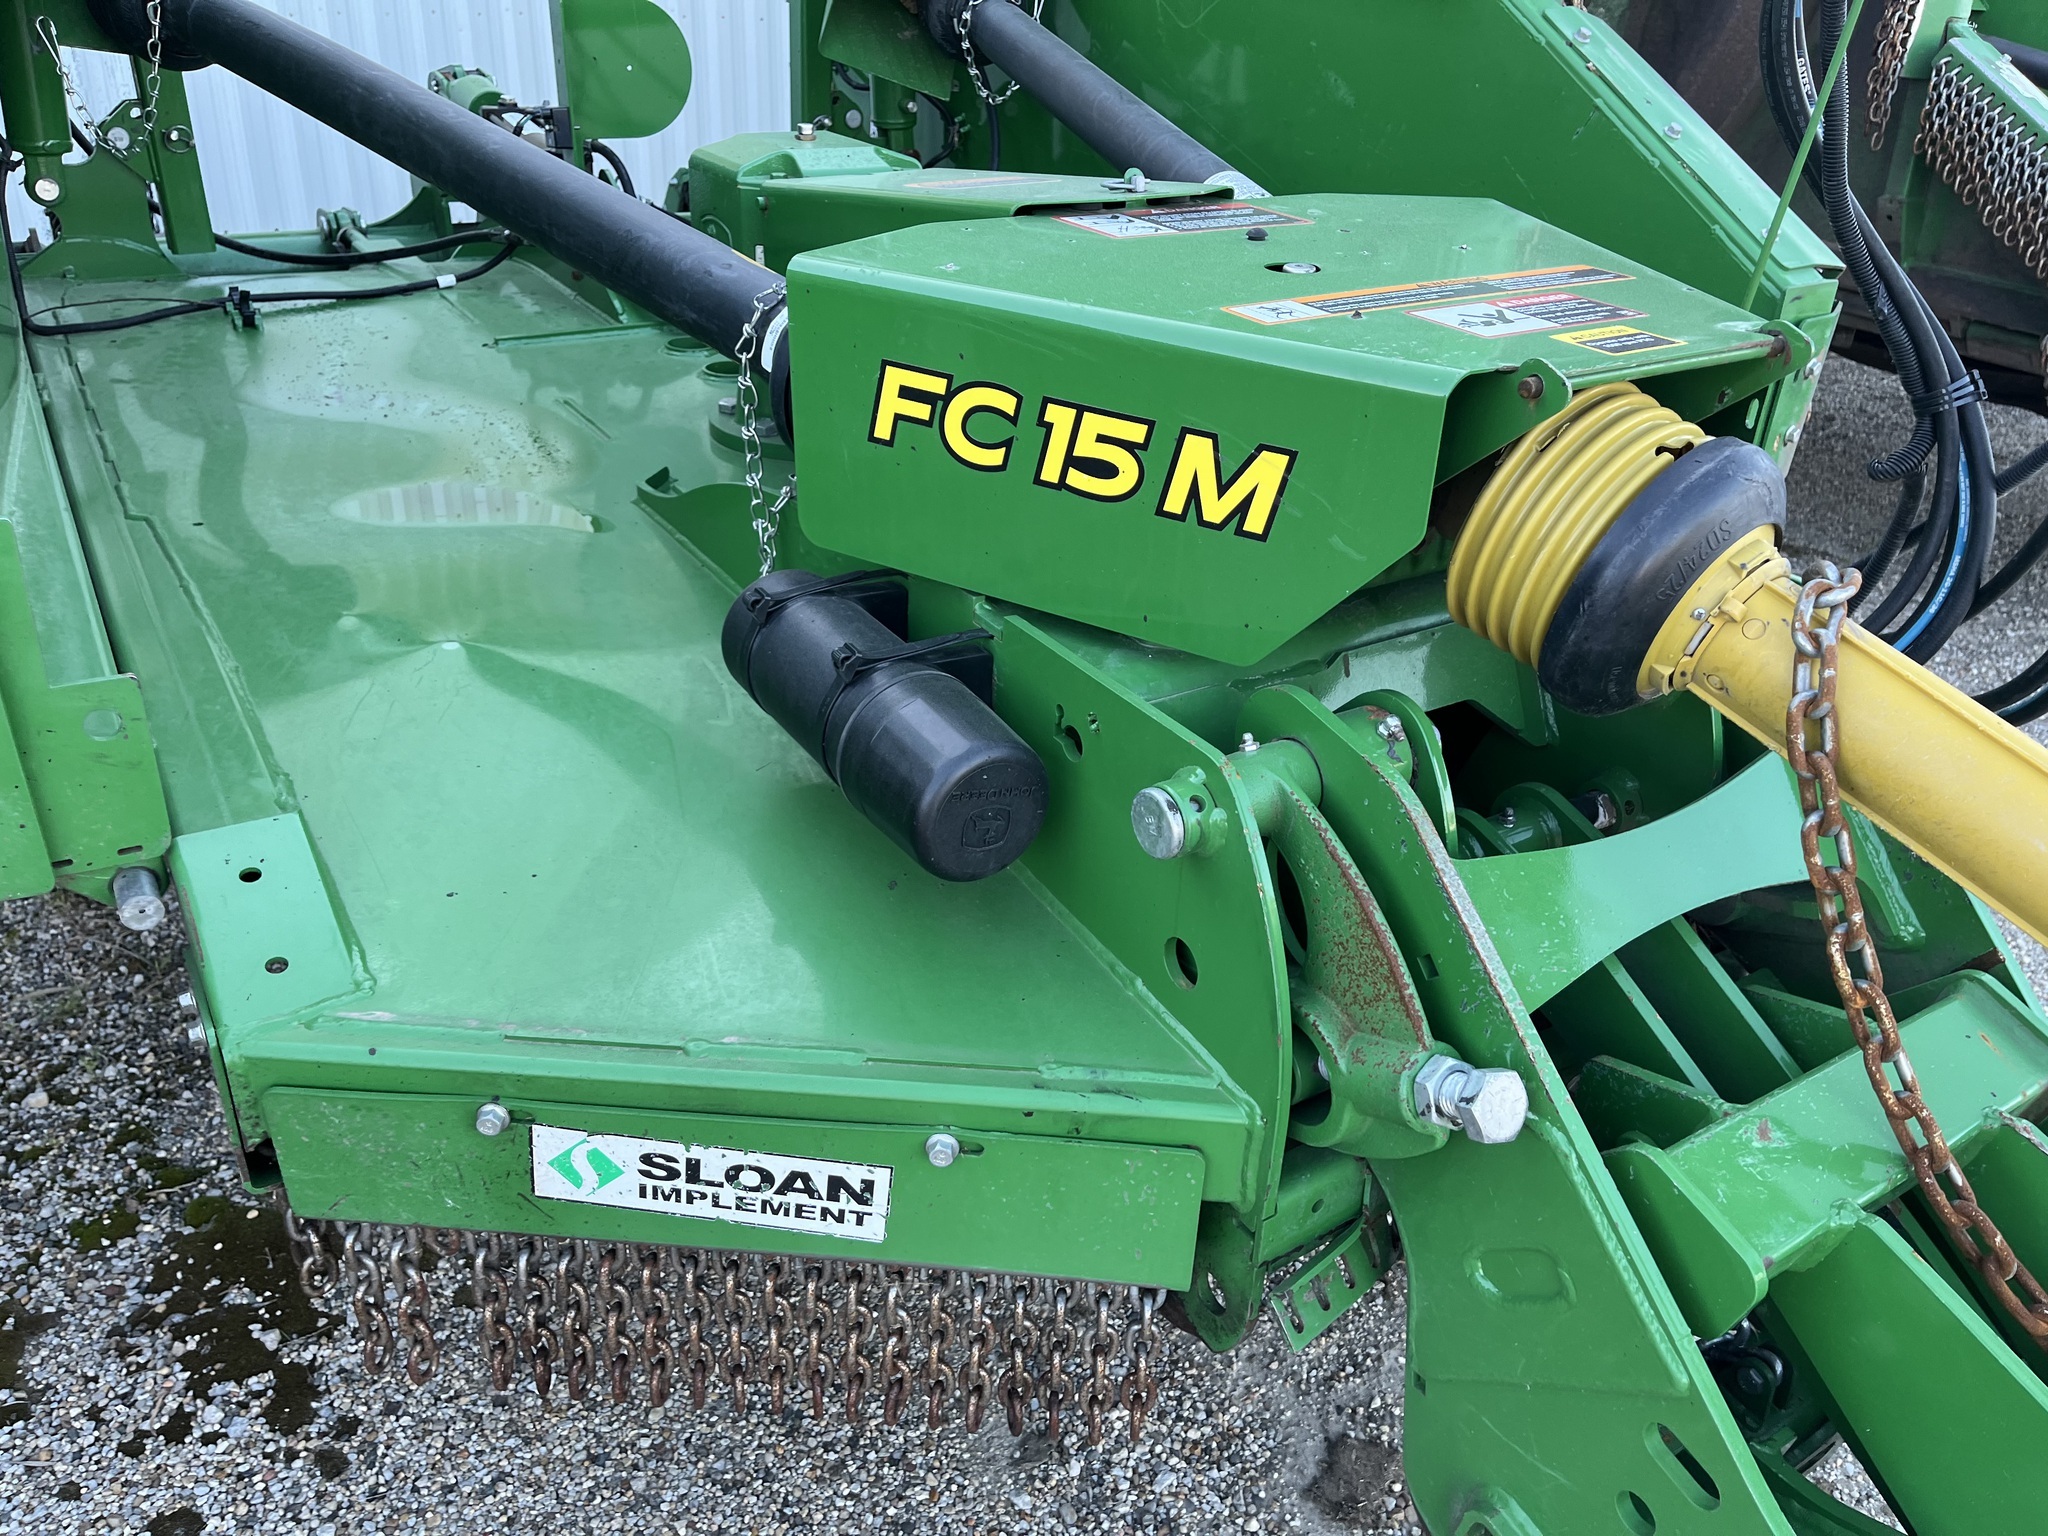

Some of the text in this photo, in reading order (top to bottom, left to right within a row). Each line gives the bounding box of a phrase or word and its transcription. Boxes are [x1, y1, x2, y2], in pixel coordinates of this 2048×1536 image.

[1797, 57, 1812, 95] GATES
[1511, 293, 1575, 307] DANGER
[1580, 328, 1630, 340] CAUTION
[868, 359, 1298, 542] FC 15 M
[1656, 518, 1731, 600] SD24/25
[951, 785, 1036, 801] JOHN DEERE
[637, 1152, 876, 1207] SLOAN
[638, 1183, 873, 1227] IMPLEMENT
